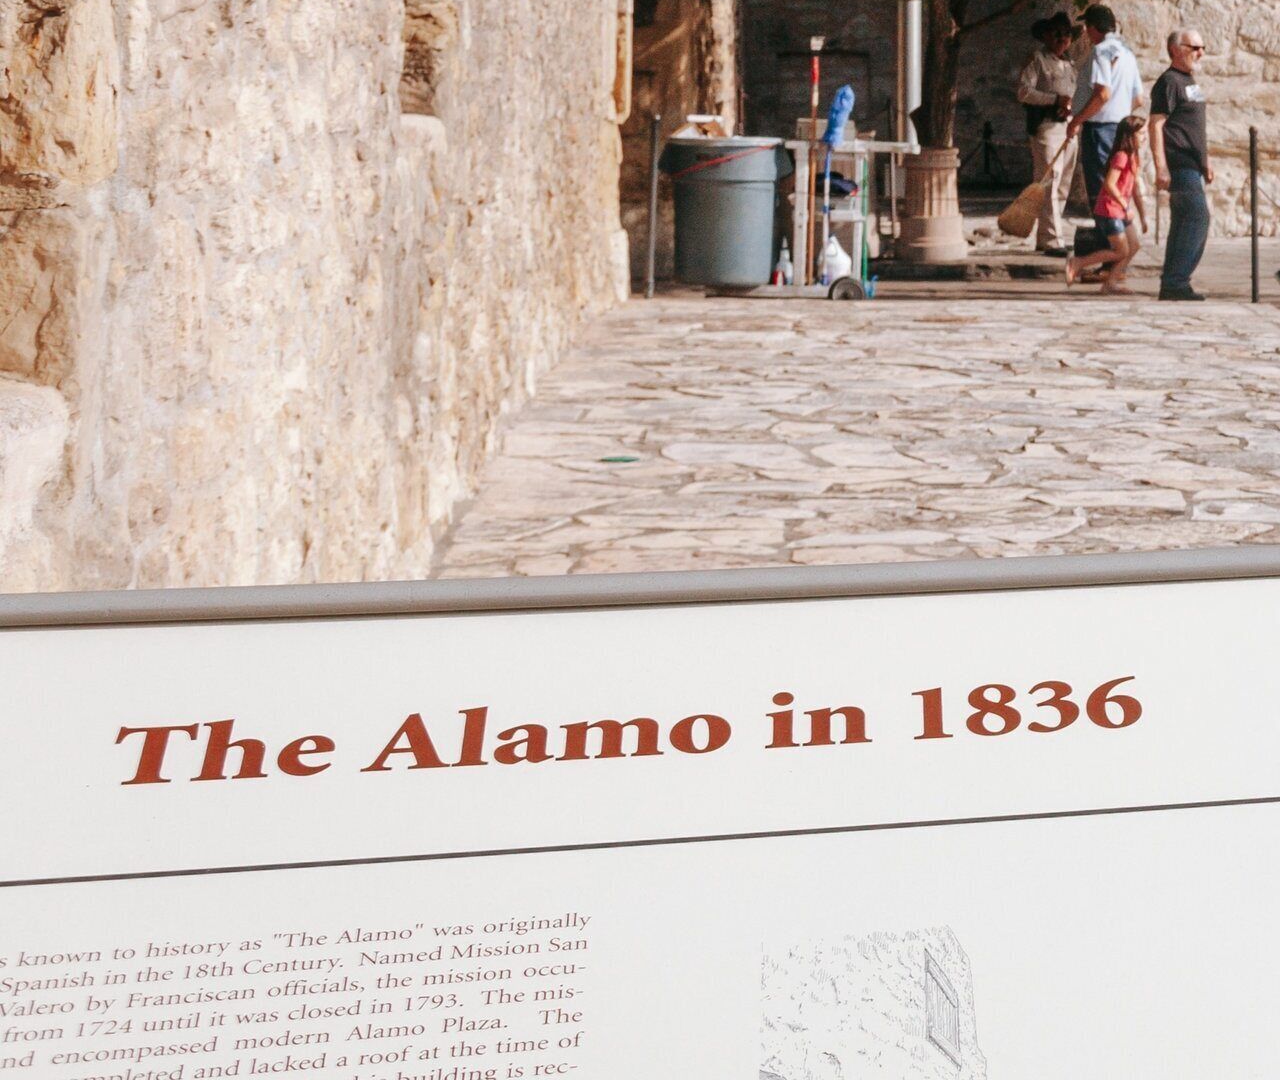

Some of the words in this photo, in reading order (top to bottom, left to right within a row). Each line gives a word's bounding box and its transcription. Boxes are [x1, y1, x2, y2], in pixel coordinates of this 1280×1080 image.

[115, 719, 336, 786] The
[361, 706, 732, 773] Alamo
[764, 691, 873, 749] in
[911, 675, 1145, 739] 1836
[0, 970, 95, 997] Spanish
[103, 969, 127, 986] in
[136, 966, 174, 983] the
[183, 961, 234, 980] 18th
[242, 957, 344, 975] Century.
[357, 945, 443, 967] Named
[449, 940, 540, 960] Mission
[547, 937, 588, 953] San
[16, 950, 102, 967] known
[113, 948, 136, 961] to
[145, 941, 231, 957] history
[238, 939, 263, 952] as
[273, 931, 328, 948] "The
[334, 923, 424, 945] Alamo"
[432, 924, 475, 937] was
[482, 912, 592, 936] originally
[0, 999, 75, 1017] Valero
[86, 995, 116, 1015] by
[125, 987, 256, 1009] Franciscan
[266, 975, 366, 998] officials,
[375, 972, 413, 990] the
[421, 966, 512, 987] mission
[523, 963, 586, 978] occu-
[2, 1026, 64, 1043] from
[76, 1018, 133, 1038] 1724
[143, 1011, 201, 1032] until
[208, 1010, 227, 1028] it
[235, 1010, 280, 1025] was
[287, 999, 362, 1021] closed
[370, 998, 393, 1015] in
[404, 993, 465, 1012] 1793.
[480, 988, 526, 1006] The
[533, 983, 584, 1002] mis-
[51, 1035, 218, 1065] encompassed
[233, 1029, 330, 1051] modern
[344, 1023, 426, 1042] Alamo
[441, 1015, 508, 1034] Plaza.
[538, 1007, 584, 1026] The
[193, 1059, 241, 1080] and
[248, 1052, 327, 1075] lacked
[335, 1055, 348, 1068] a
[357, 1044, 414, 1066] roof
[417, 1046, 441, 1061] at
[449, 1040, 487, 1058] the
[495, 1037, 550, 1054] time
[557, 1030, 585, 1049] of
[396, 1066, 498, 1080] bilding
[506, 1062, 524, 1079] is
[533, 1062, 578, 1077] rec-
